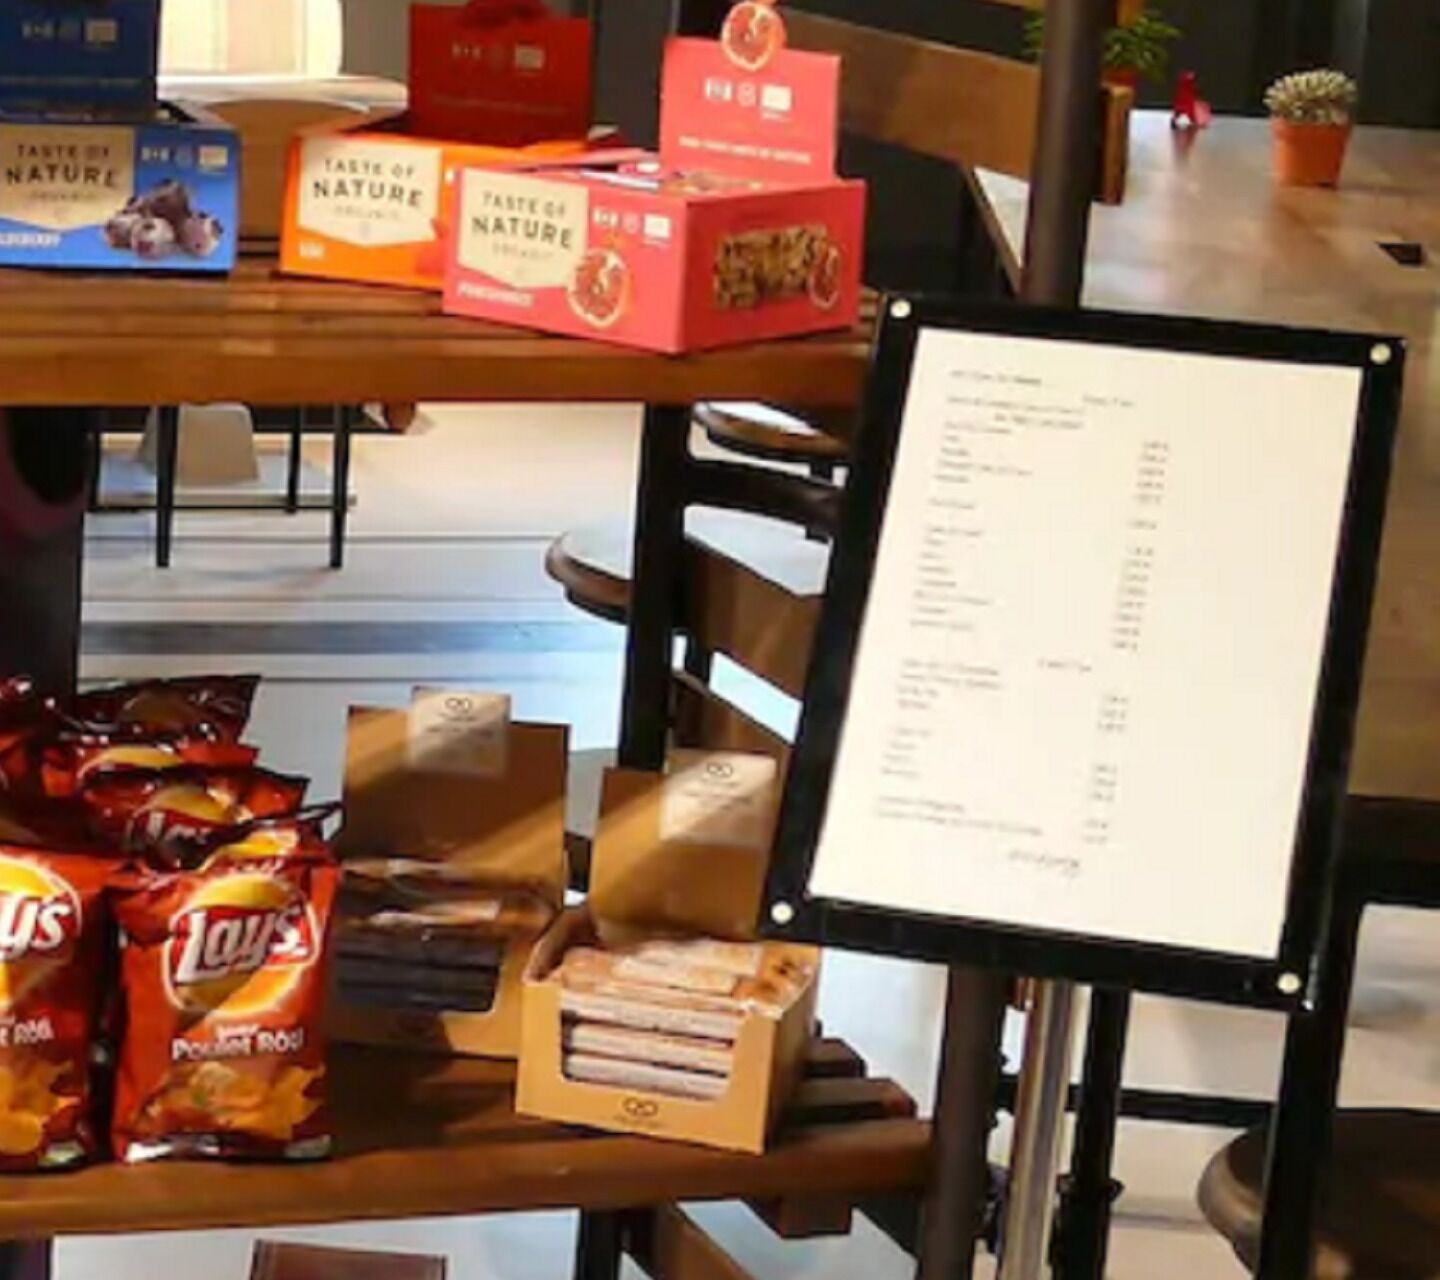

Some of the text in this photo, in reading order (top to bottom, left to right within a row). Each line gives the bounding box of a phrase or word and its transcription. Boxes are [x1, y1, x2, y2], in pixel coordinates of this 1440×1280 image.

[17, 143, 77, 158] TASTE
[6, 164, 115, 188] NATURE
[324, 157, 382, 176] TASTE
[313, 178, 423, 208] NATURE
[483, 190, 538, 213] TASTE
[472, 217, 574, 250] NATURE
[172, 1029, 254, 1061] Poulet
